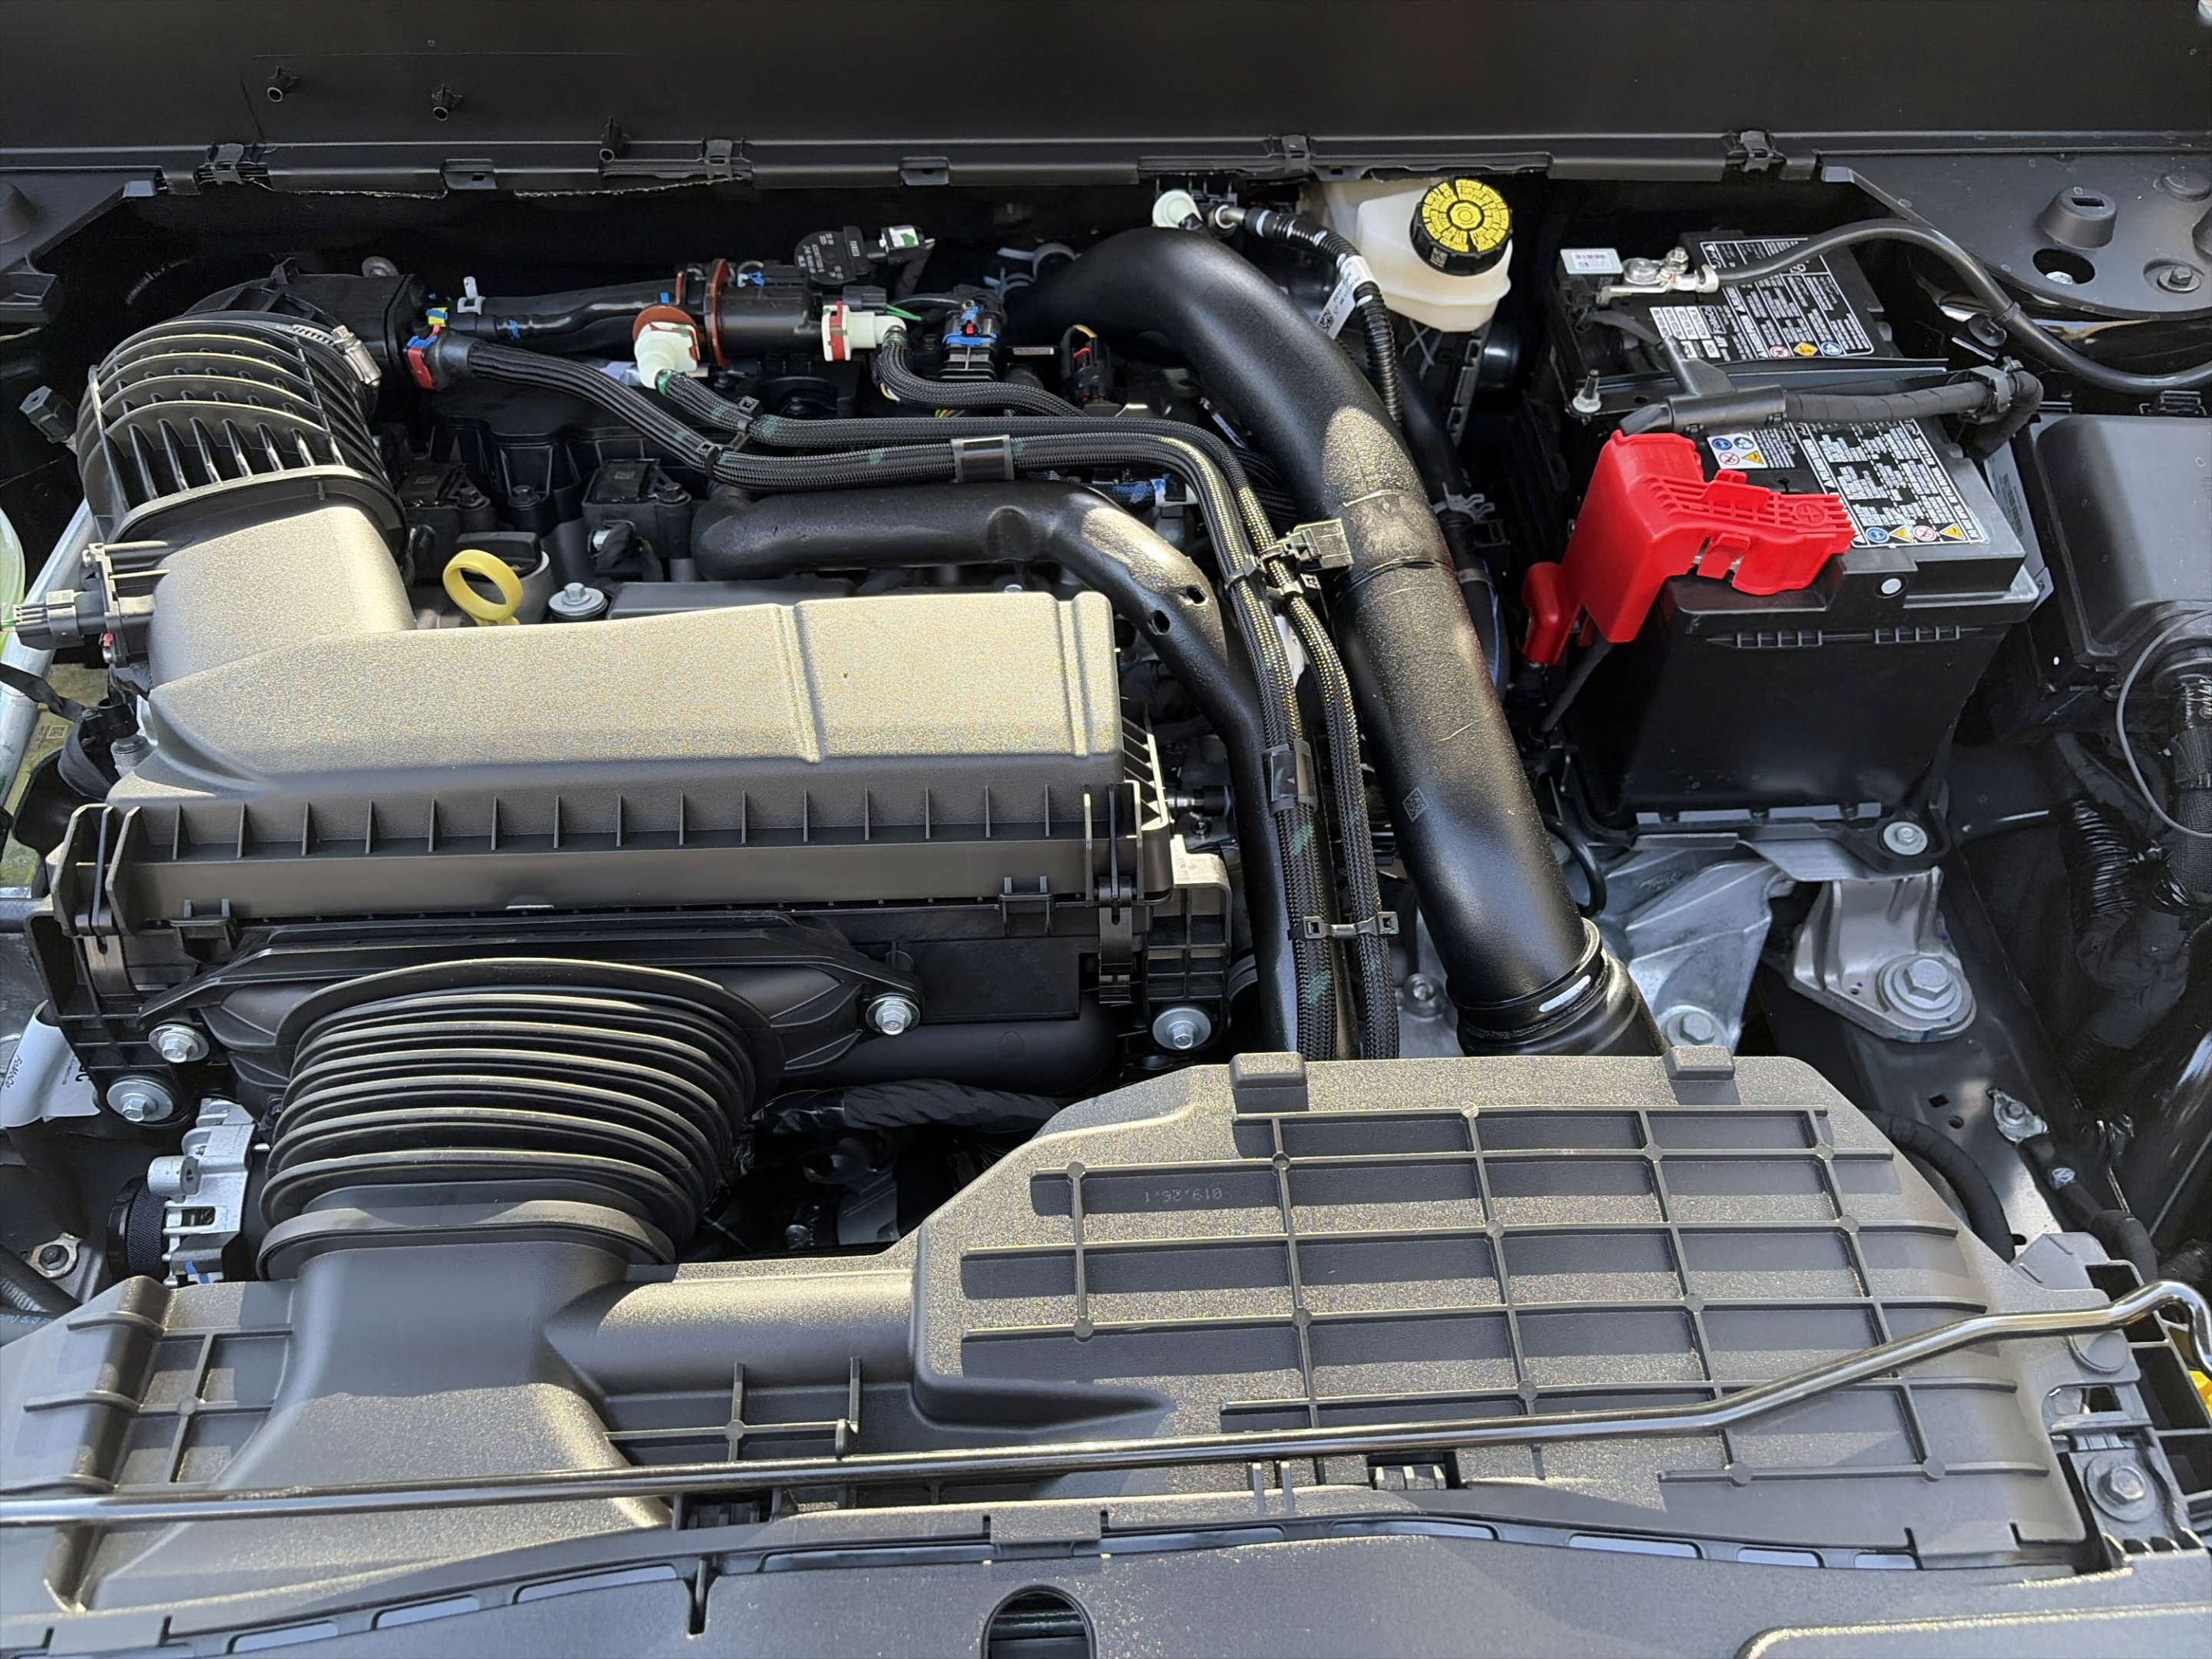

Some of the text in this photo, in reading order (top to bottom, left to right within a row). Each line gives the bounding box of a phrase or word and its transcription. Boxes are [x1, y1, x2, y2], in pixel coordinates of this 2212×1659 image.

[1704, 307, 1723, 332] FoMoCo
[1941, 486, 1955, 495] PAS
[1962, 519, 1974, 529] NOT
[5, 1055, 22, 1088] FoMoCo
